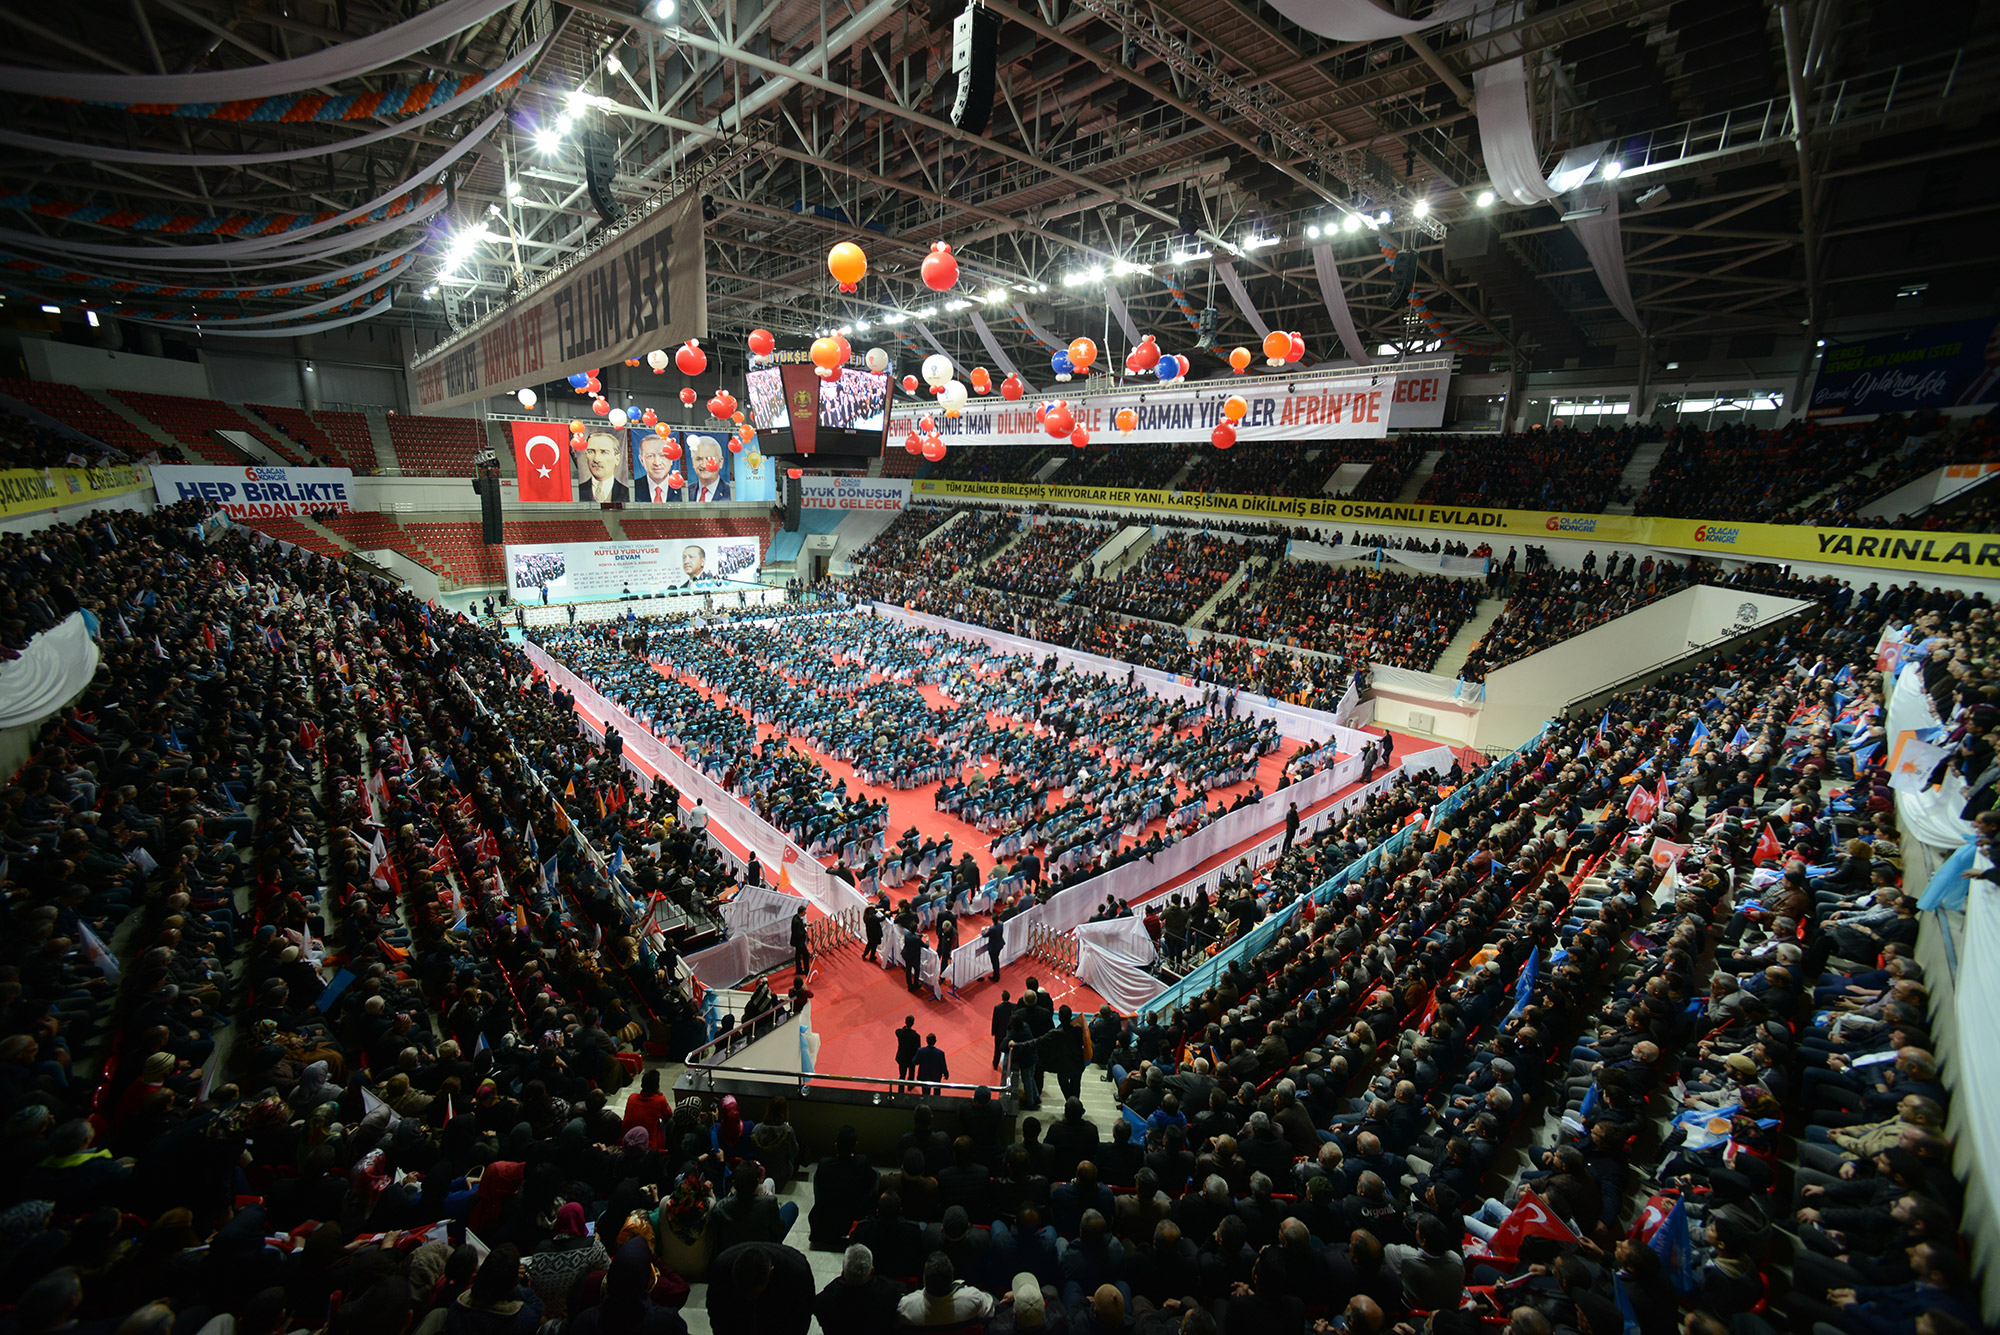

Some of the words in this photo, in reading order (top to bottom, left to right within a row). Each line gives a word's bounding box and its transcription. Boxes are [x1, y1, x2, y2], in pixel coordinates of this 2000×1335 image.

[889, 415, 912, 437] EVHİD
[966, 411, 991, 435] İMAN
[997, 408, 1039, 434] DİLİNDE
[1109, 403, 1194, 431] KRAMAN
[1199, 393, 1275, 428] YİĞLER
[1280, 388, 1382, 426] AFRİN'DE
[175, 482, 237, 502] HEP
[801, 487, 835, 497] ÜYÜK
[219, 503, 299, 518] RMADAN
[801, 498, 836, 508] UTLU
[839, 498, 902, 510] GELECEK
[945, 482, 962, 492] TÜM
[963, 483, 1000, 495] ZALİMLER
[1001, 484, 1046, 499] BİRLEŞMİŞ
[1048, 487, 1107, 501] YIKIYORLAR
[1109, 490, 1131, 503] HER
[1167, 493, 1239, 510] KARŞISINA
[1241, 496, 1307, 517] DİKİLMİŞ
[1310, 499, 1337, 517] BİR
[1345, 503, 1424, 523] OSMANLI
[1429, 510, 1508, 529] EVLADI.
[1818, 533, 2000, 567] YARINLAR
